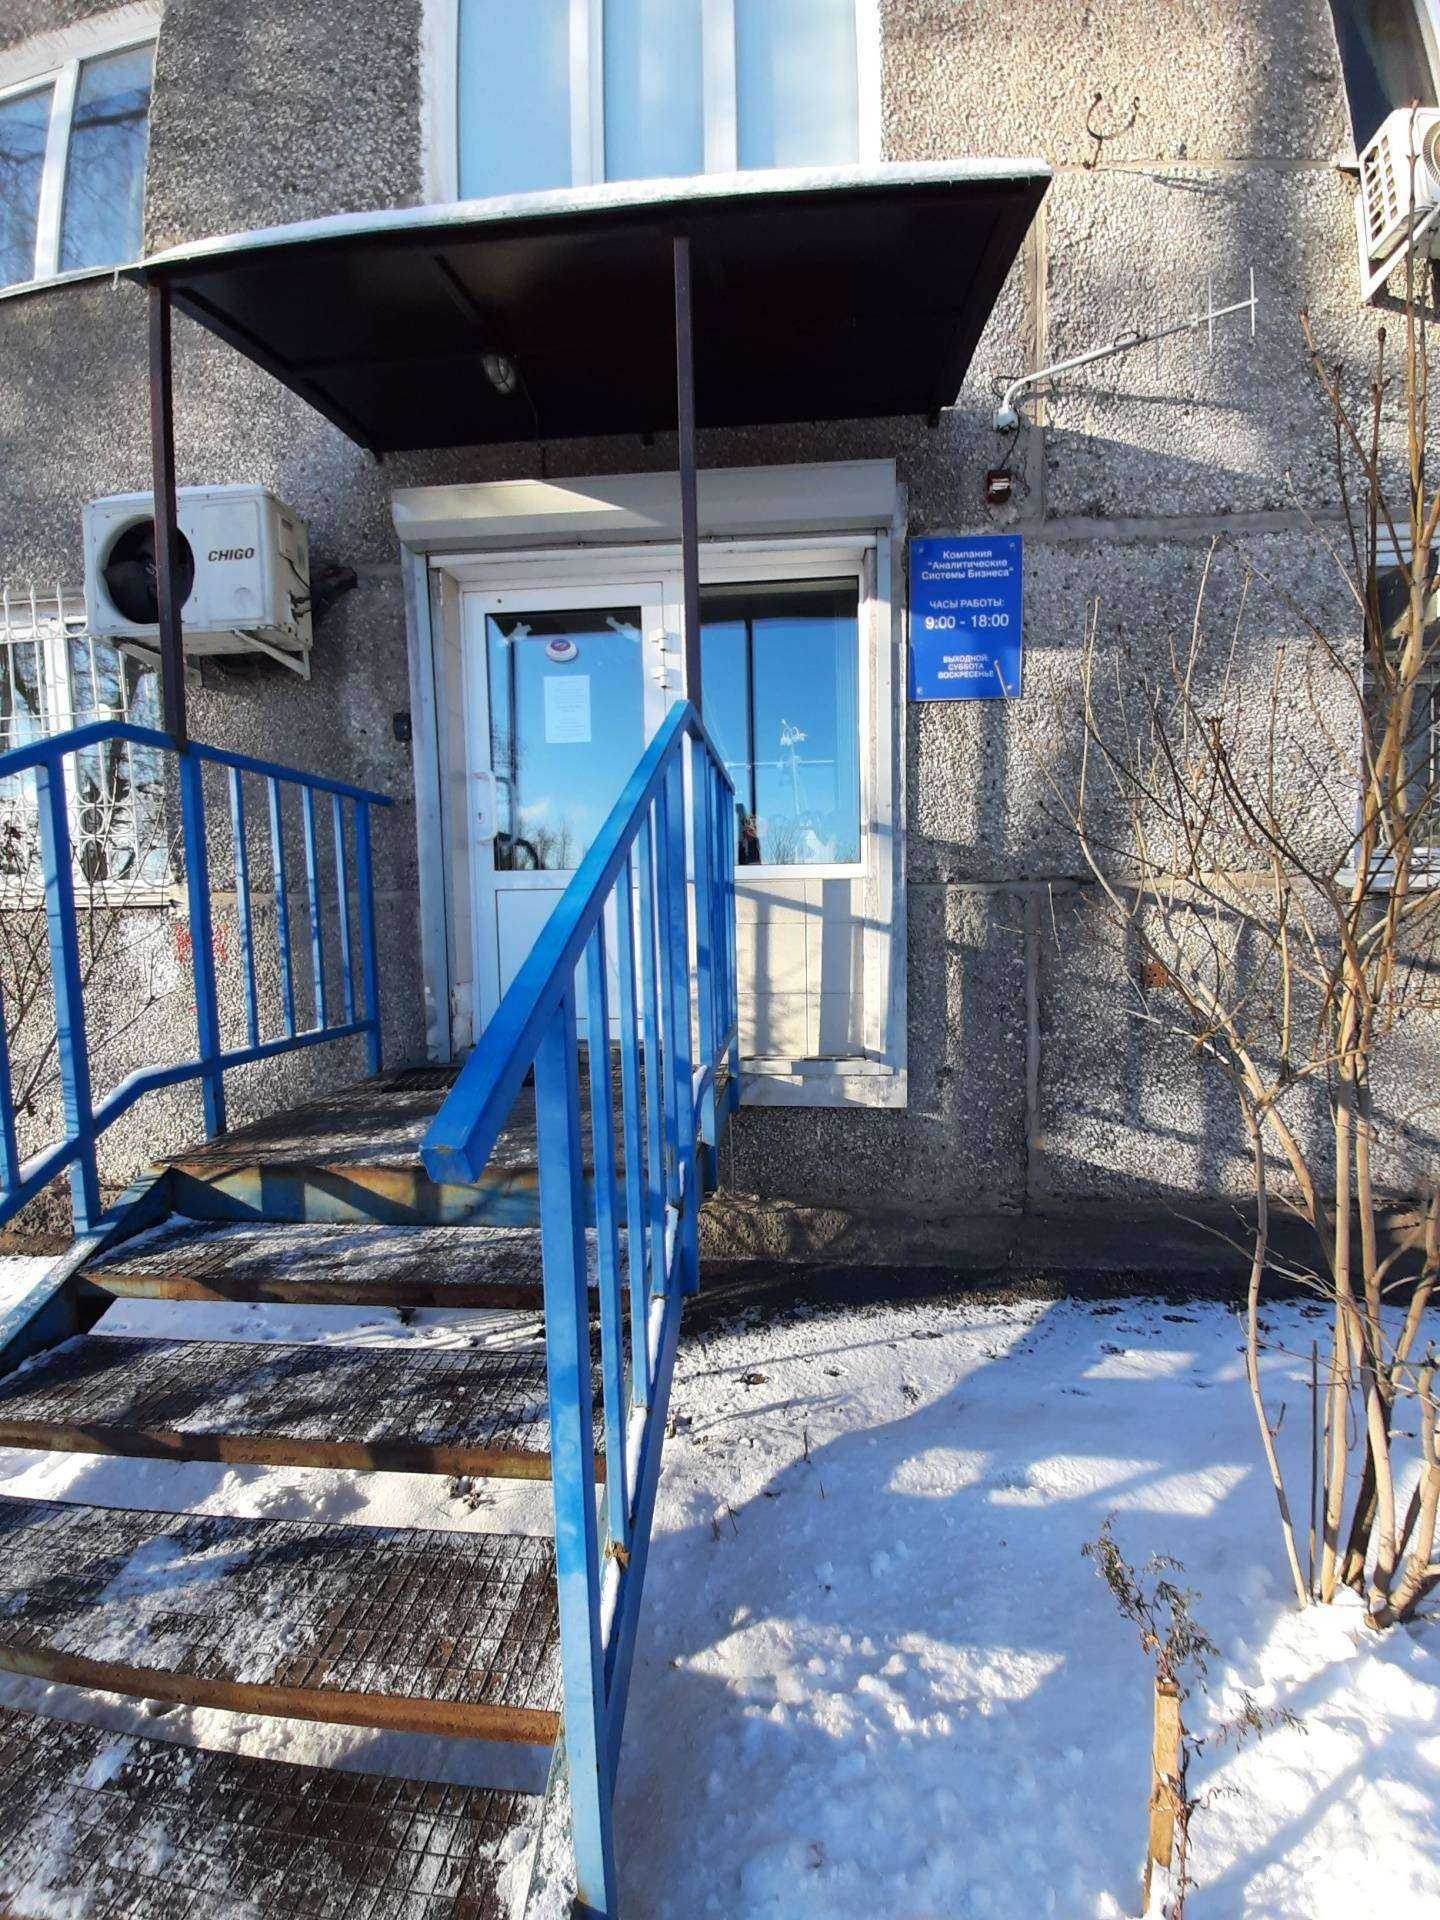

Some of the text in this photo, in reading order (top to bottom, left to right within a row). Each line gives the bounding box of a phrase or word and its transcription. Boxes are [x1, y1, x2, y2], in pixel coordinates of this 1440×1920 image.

[208, 547, 255, 562] CHIGO
[943, 550, 992, 559] Компания
[928, 560, 1007, 570] "Аналитические
[921, 567, 1014, 580] Системы Бизнеса"
[929, 599, 1005, 609] ЧАСЫ РАБОТЫ:
[925, 616, 956, 630] 9:00
[971, 614, 1010, 628] 18:00
[947, 663, 984, 671] СУББОТА
